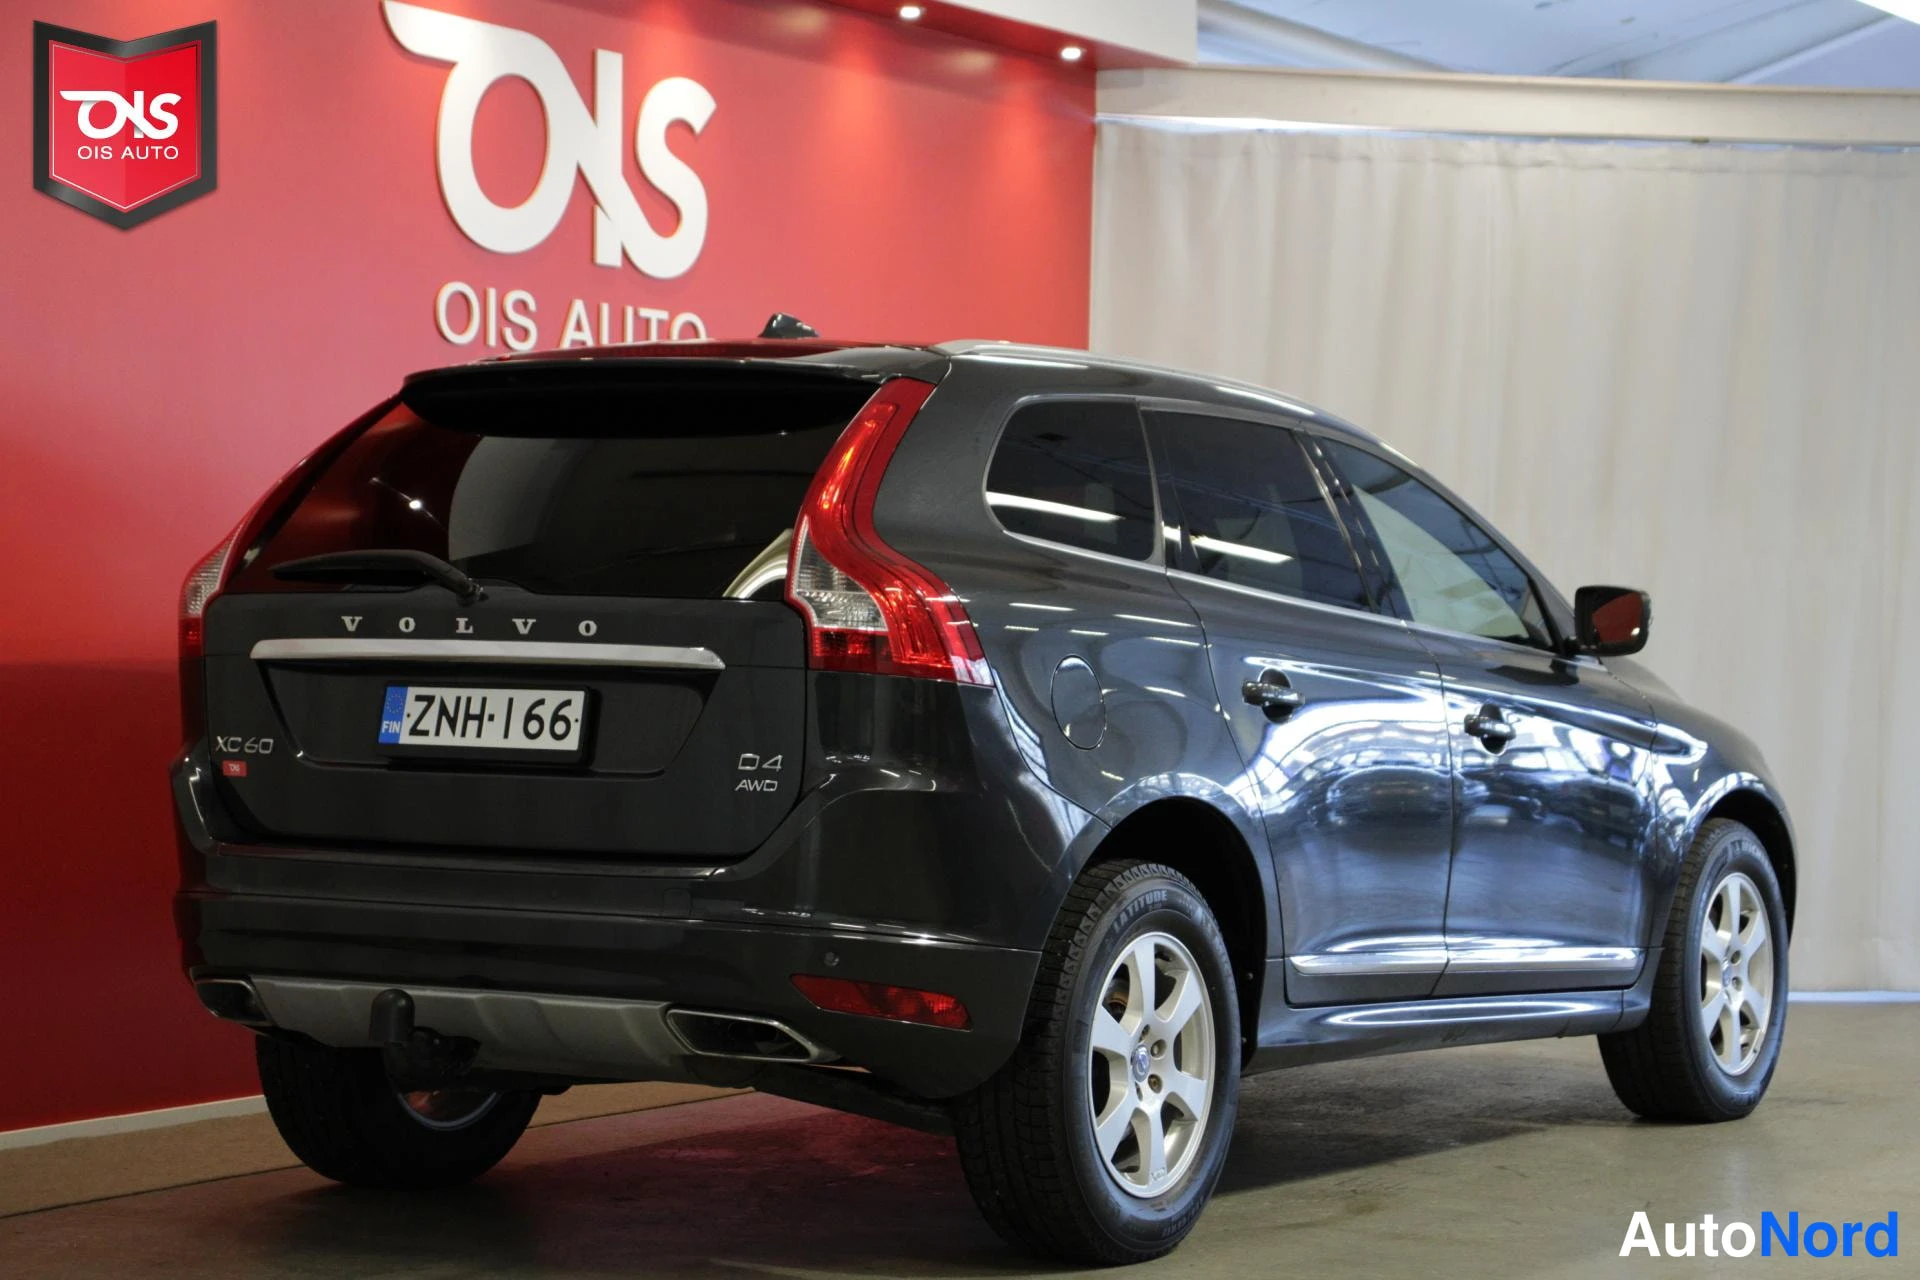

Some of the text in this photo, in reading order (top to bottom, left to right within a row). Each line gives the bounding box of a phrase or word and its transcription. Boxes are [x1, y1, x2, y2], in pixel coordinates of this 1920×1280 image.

[436, 282, 538, 352] OIS
[341, 615, 598, 637] VOLVO
[381, 720, 400, 733] FIN
[409, 694, 572, 741] ZNH-166
[216, 736, 274, 754] XC60
[738, 753, 783, 772] D4
[735, 779, 778, 792] AWD
[1112, 889, 1168, 933] LATITUDE
